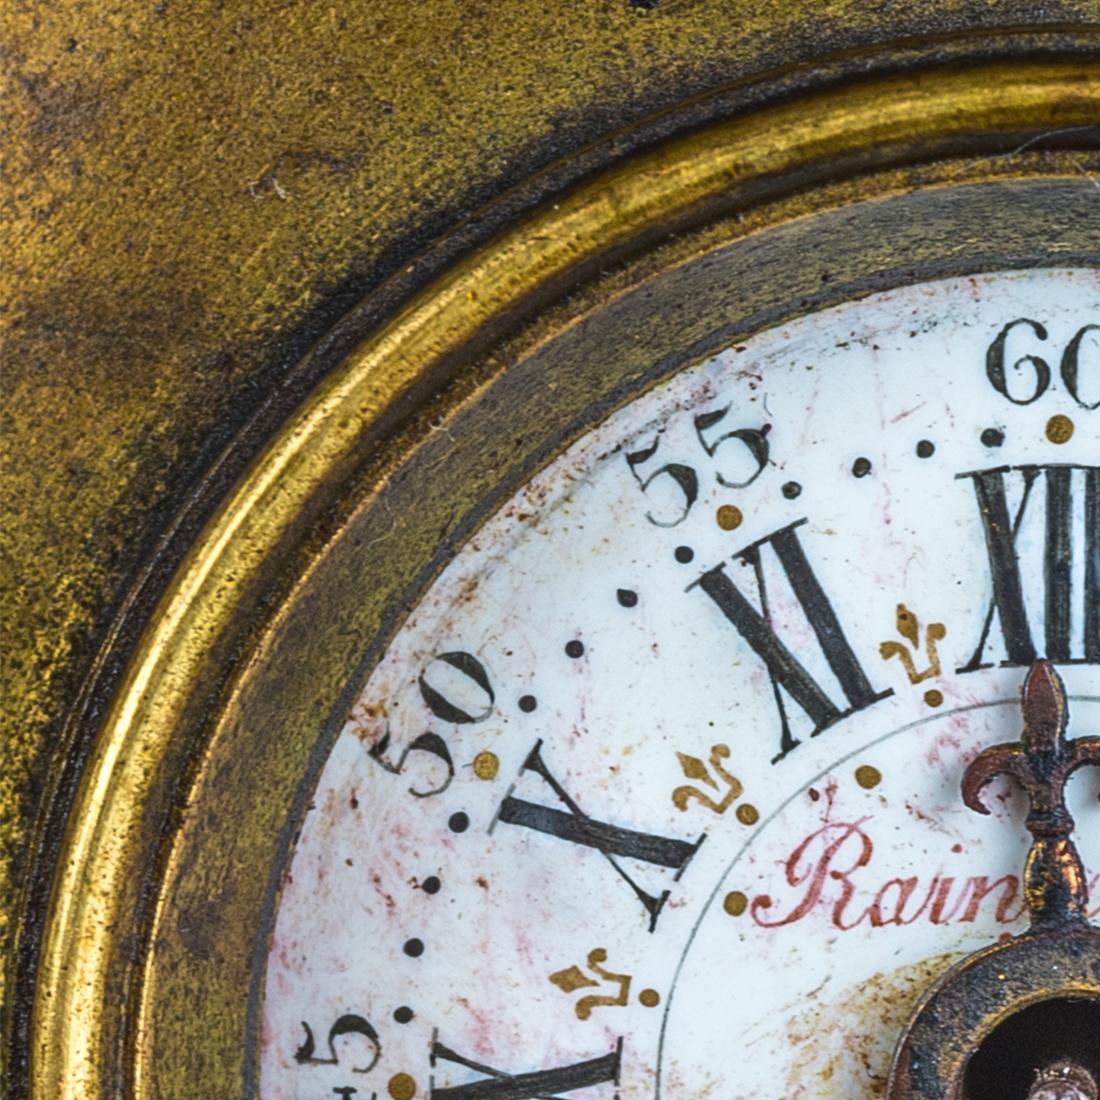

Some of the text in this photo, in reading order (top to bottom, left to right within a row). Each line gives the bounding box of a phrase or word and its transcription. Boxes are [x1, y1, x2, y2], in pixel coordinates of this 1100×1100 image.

[626, 403, 771, 527] 55
[368, 651, 495, 797] 50
[685, 518, 894, 764] XI
[488, 738, 706, 933] X
